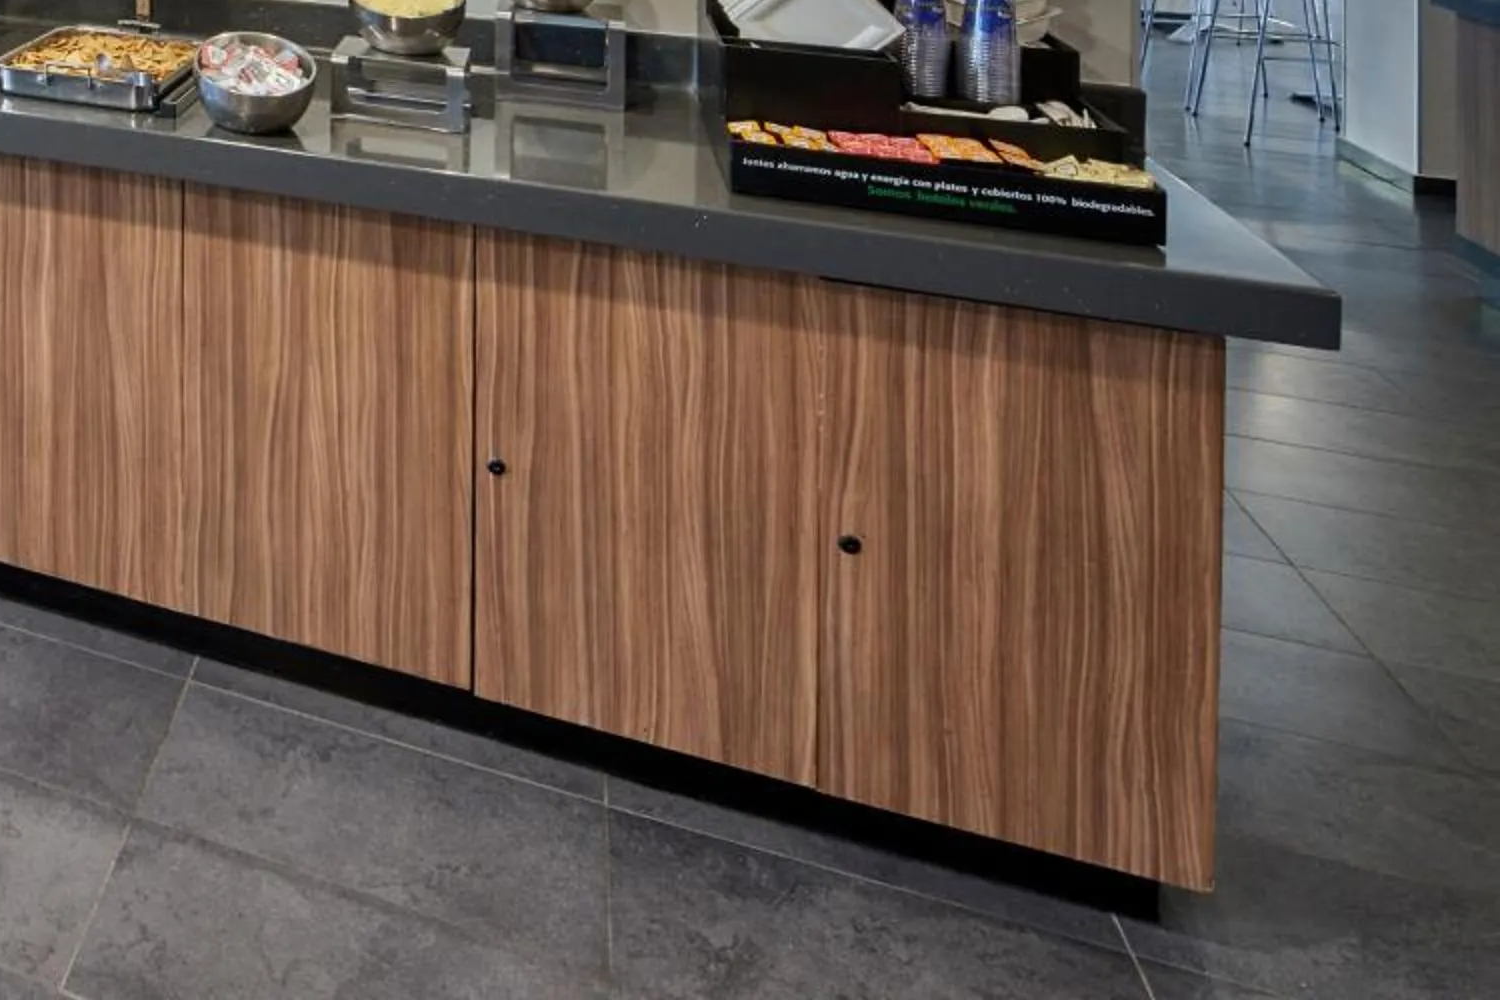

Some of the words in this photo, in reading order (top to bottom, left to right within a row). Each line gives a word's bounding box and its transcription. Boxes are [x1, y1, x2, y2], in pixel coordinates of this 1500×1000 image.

[834, 168, 859, 180] agua
[862, 172, 869, 182] y
[912, 179, 933, 189] con
[971, 186, 979, 196] y
[981, 186, 1033, 201] cubiertos
[1035, 192, 1067, 206] 100%
